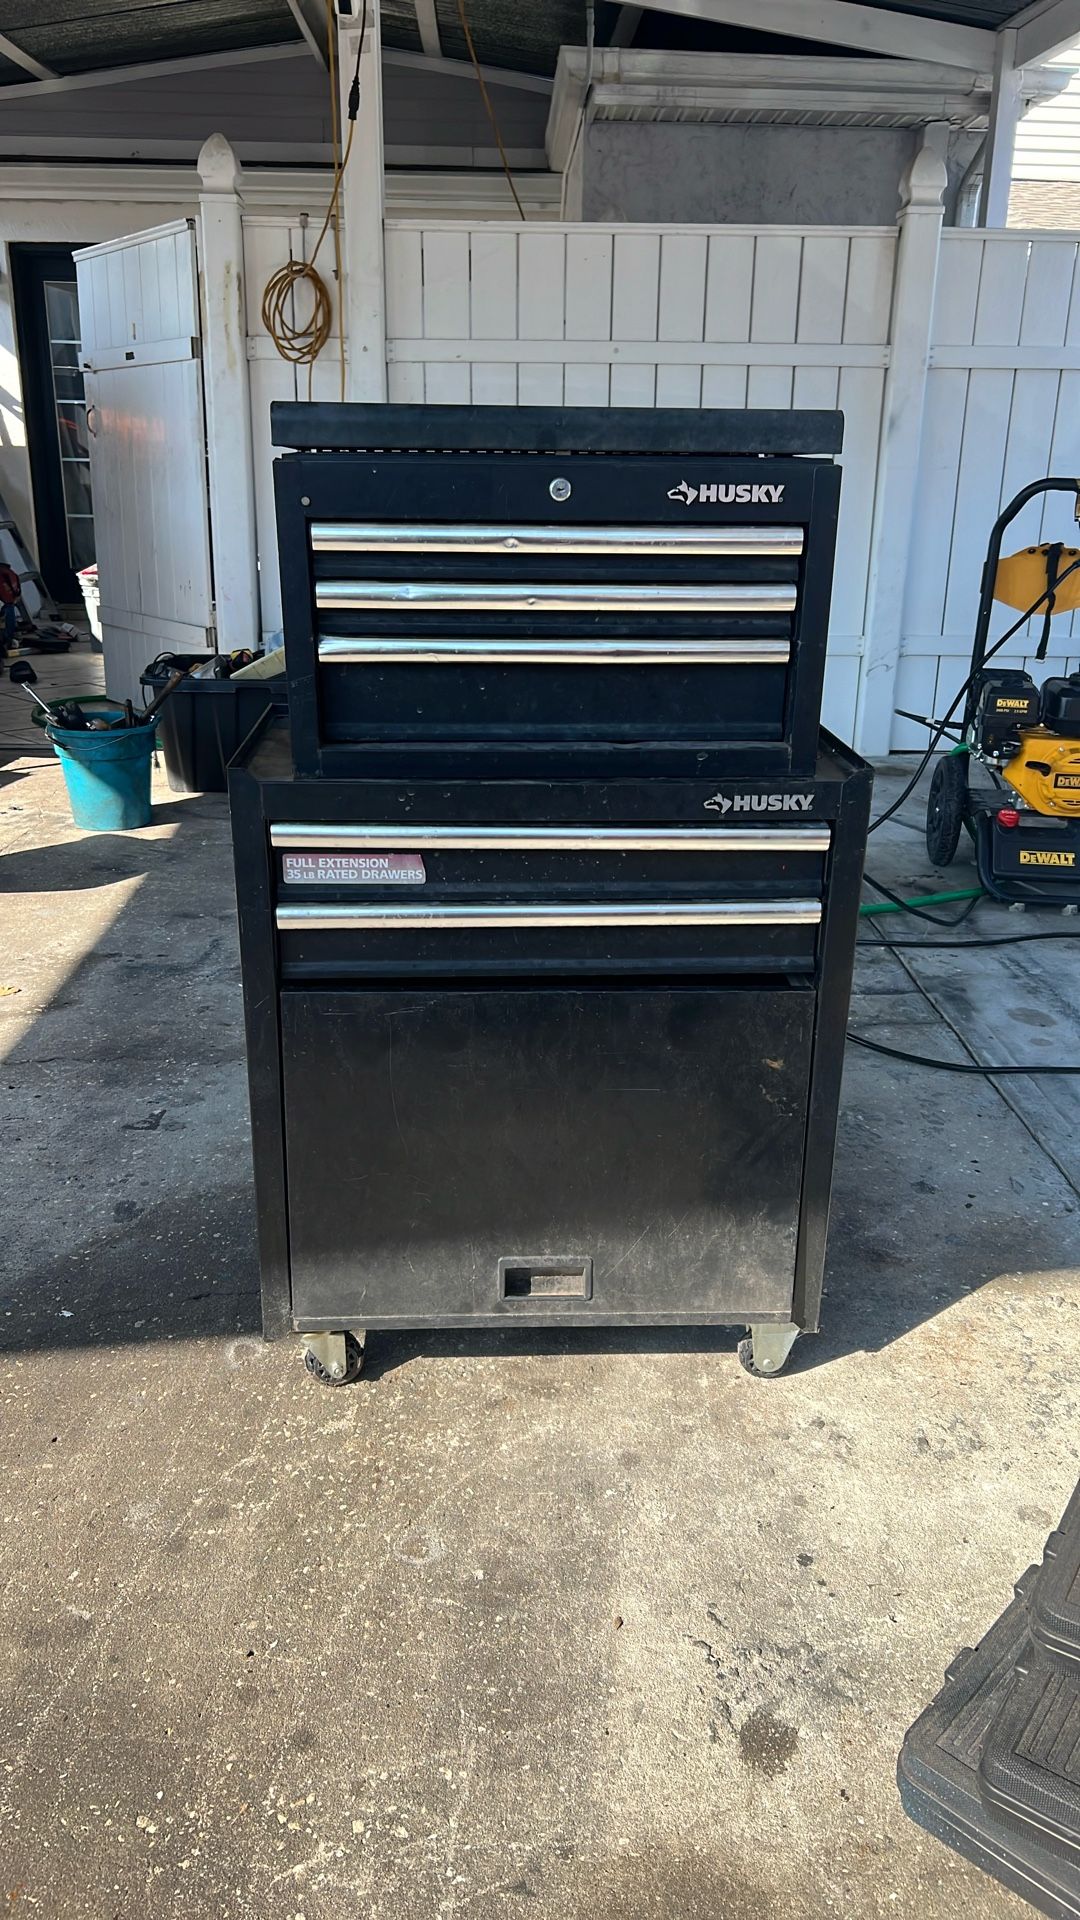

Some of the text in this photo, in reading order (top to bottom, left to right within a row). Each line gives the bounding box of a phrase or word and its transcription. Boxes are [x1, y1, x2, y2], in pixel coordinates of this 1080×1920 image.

[699, 484, 785, 503] HUSKY
[733, 794, 815, 811] HUSKY
[286, 858, 389, 868] FULL EXTENSION
[287, 869, 423, 879] 35 LB RATED DRAWERS
